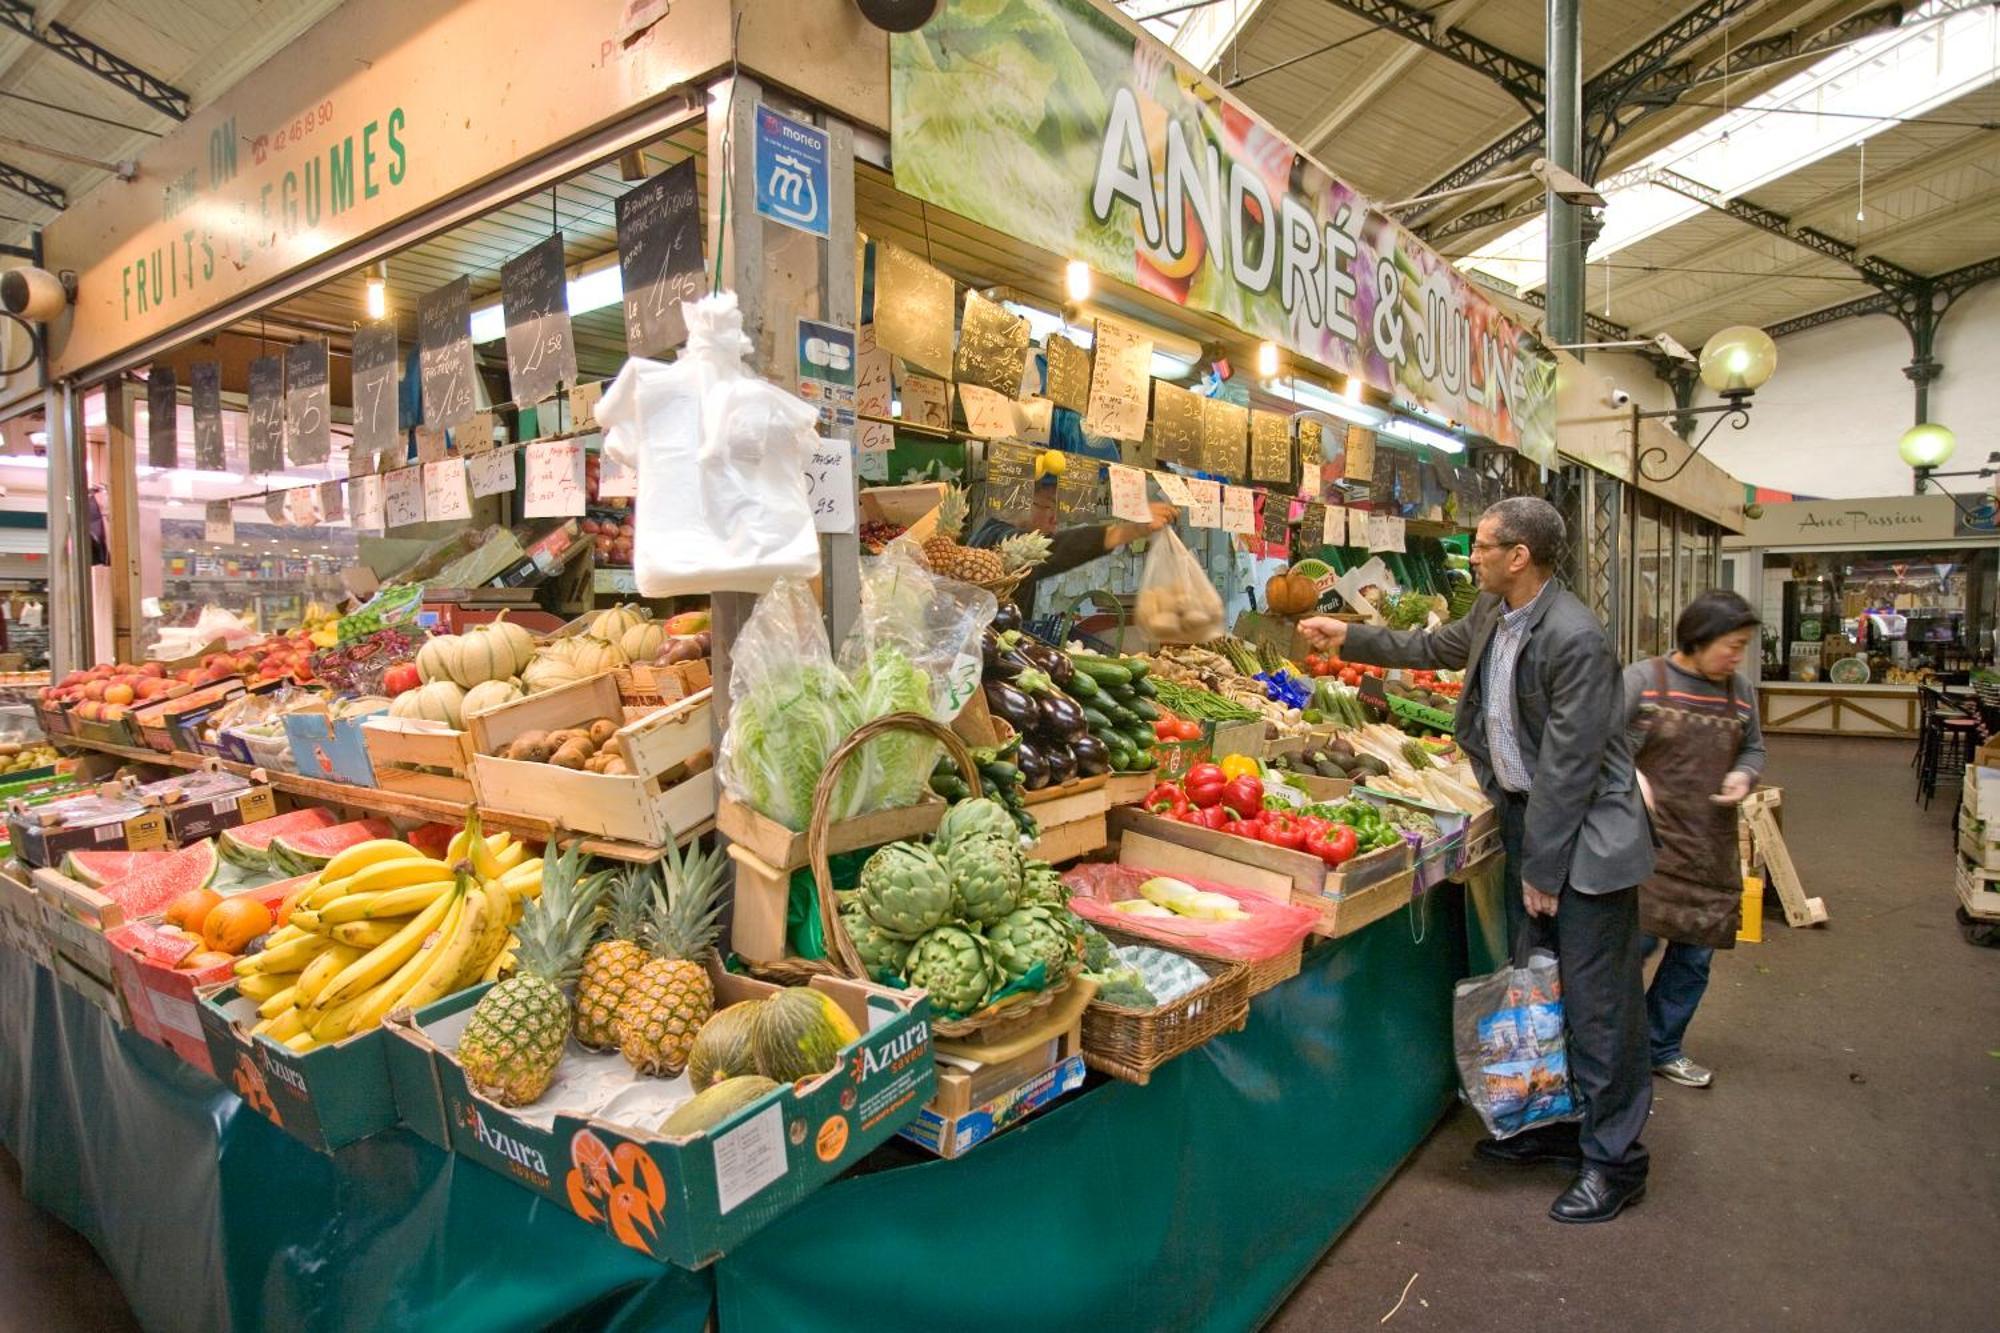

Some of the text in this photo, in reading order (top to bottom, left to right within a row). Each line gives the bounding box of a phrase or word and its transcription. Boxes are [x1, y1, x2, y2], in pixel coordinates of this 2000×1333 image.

[317, 100, 334, 126] 90
[782, 124, 822, 151] moneo
[1090, 87, 1359, 342] ANDRÉ
[1373, 256, 1407, 367] &
[122, 227, 215, 321] FRUITS
[262, 1052, 308, 1094] Azura
[861, 1020, 929, 1082] Azura
[476, 1110, 549, 1177] Azura
